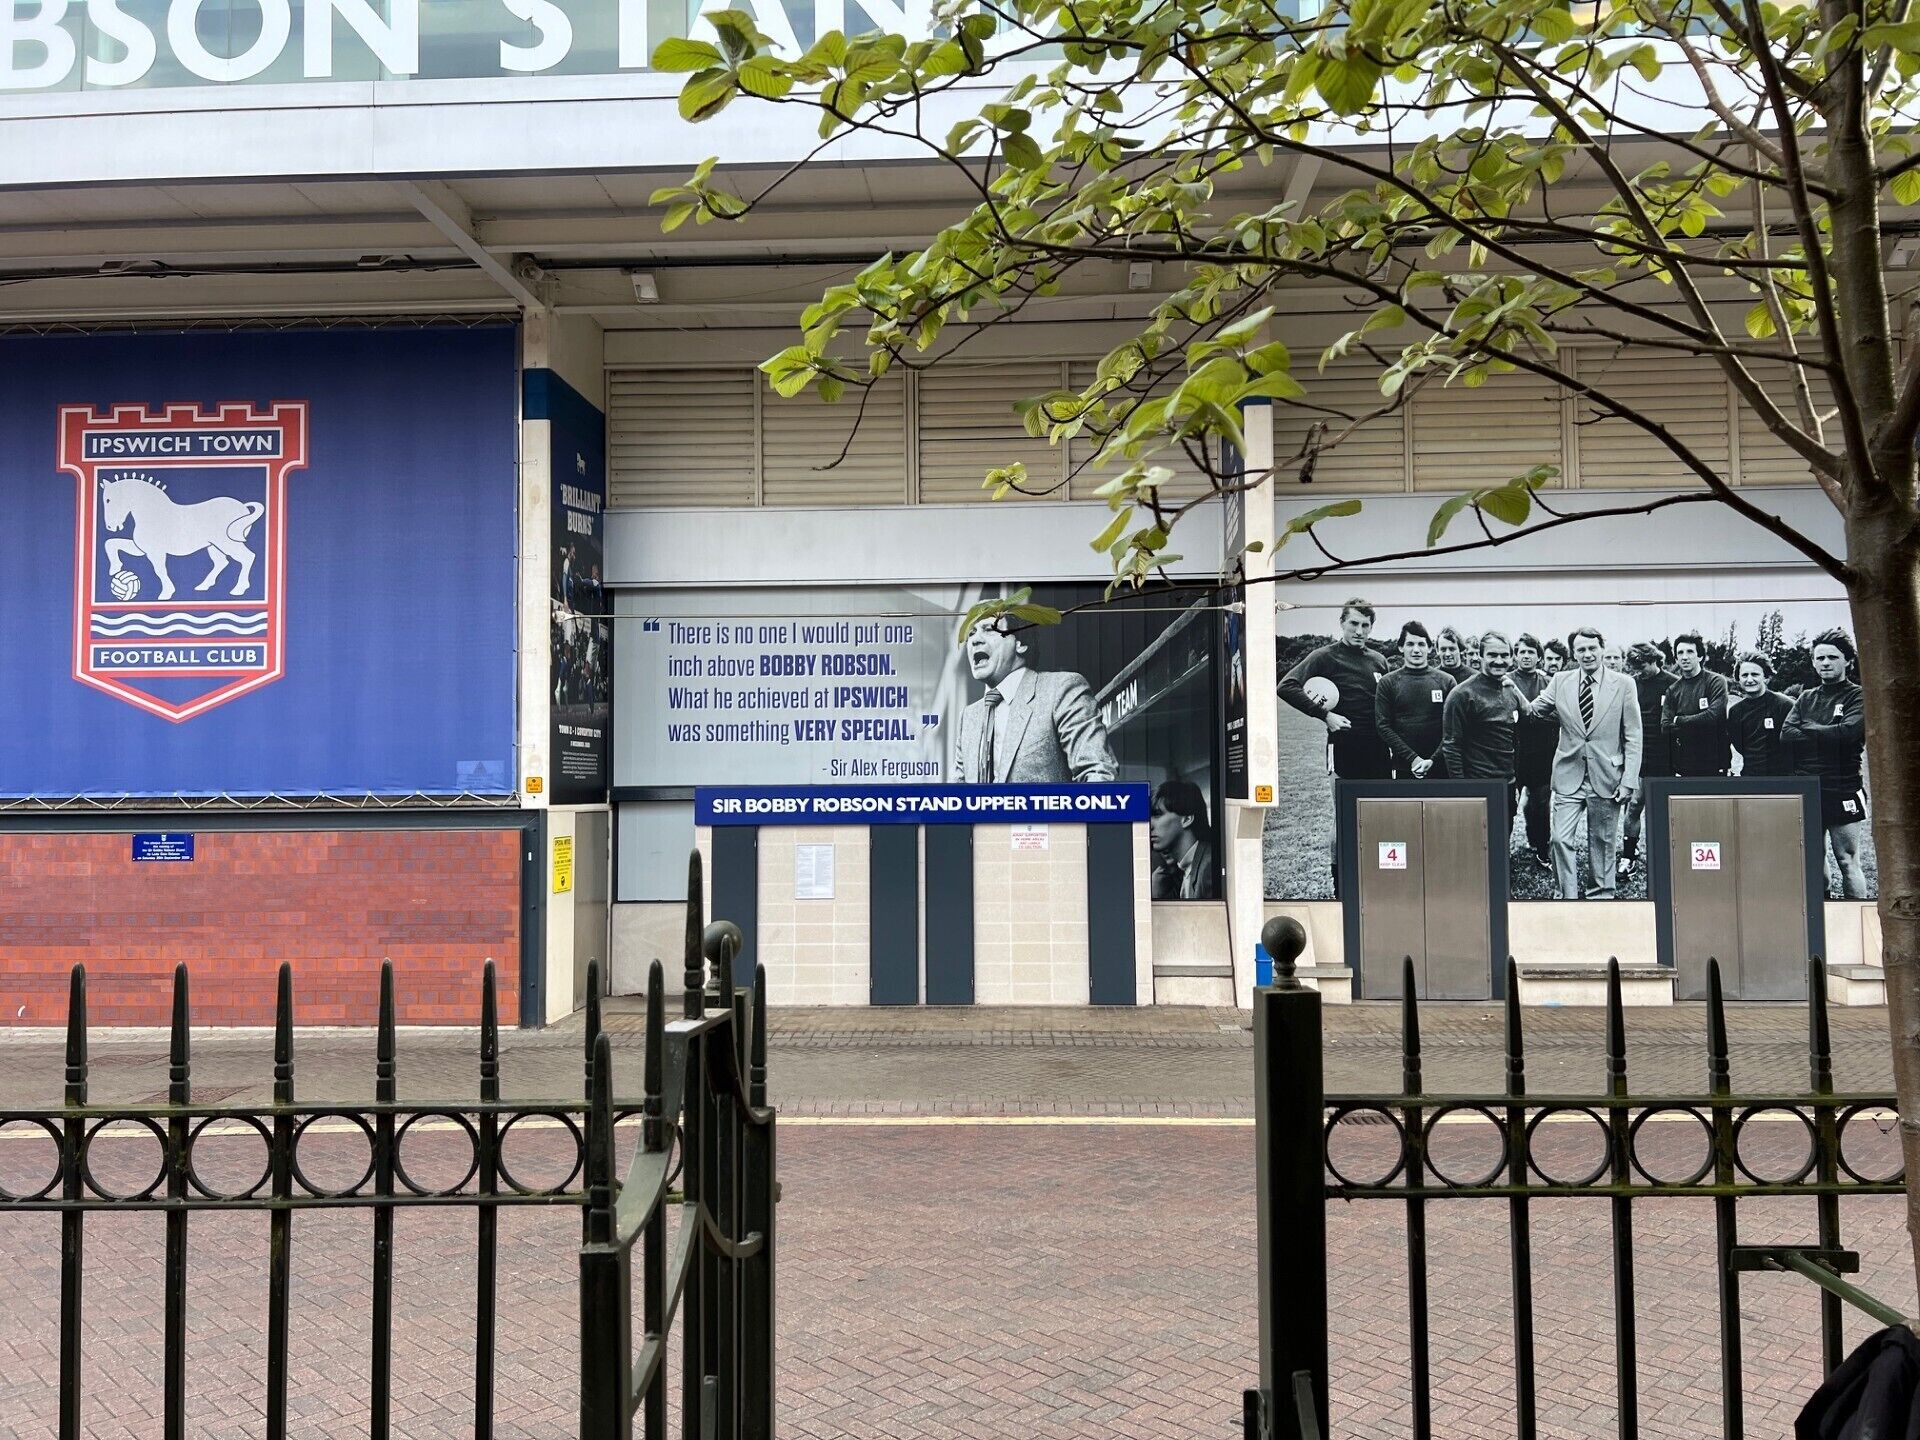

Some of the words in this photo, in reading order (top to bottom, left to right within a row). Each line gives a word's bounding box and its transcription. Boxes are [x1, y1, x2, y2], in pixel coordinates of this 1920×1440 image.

[92, 436, 191, 454] IPSWICH
[199, 434, 273, 452] TOWN
[668, 623, 711, 644] There
[716, 623, 730, 644] is
[735, 626, 754, 644] no
[759, 626, 788, 644] one
[792, 622, 797, 644] I
[802, 622, 849, 644] would
[855, 624, 881, 647] put
[884, 625, 913, 644] one
[100, 649, 200, 664] FOOTBALL
[206, 649, 257, 663] CLUB
[668, 655, 702, 676] inch
[708, 655, 755, 676] above
[759, 654, 816, 676] BOBBY
[821, 653, 896, 676] ROBSON.
[668, 687, 709, 709] What
[713, 687, 733, 709] he
[738, 686, 808, 709] achieved
[814, 687, 830, 709] at
[834, 686, 908, 708] IPSWICH
[1116, 679, 1138, 719] TEAM
[668, 723, 701, 742] was
[706, 719, 789, 746] something
[794, 718, 837, 741] VERY
[841, 718, 915, 741] SPECIAL.
[831, 758, 847, 777] Sir
[851, 758, 878, 777] Alex
[882, 758, 939, 779] Ferguson
[712, 798, 742, 813] SIR
[745, 798, 810, 813] BOBBY
[813, 797, 893, 813] ROBSON
[896, 796, 963, 812] STAND
[966, 795, 1029, 811] UPPER
[1030, 795, 1074, 811] TIER
[1075, 794, 1131, 811] ONLY
[1387, 848, 1398, 861] 4
[1695, 848, 1716, 862] 3A
